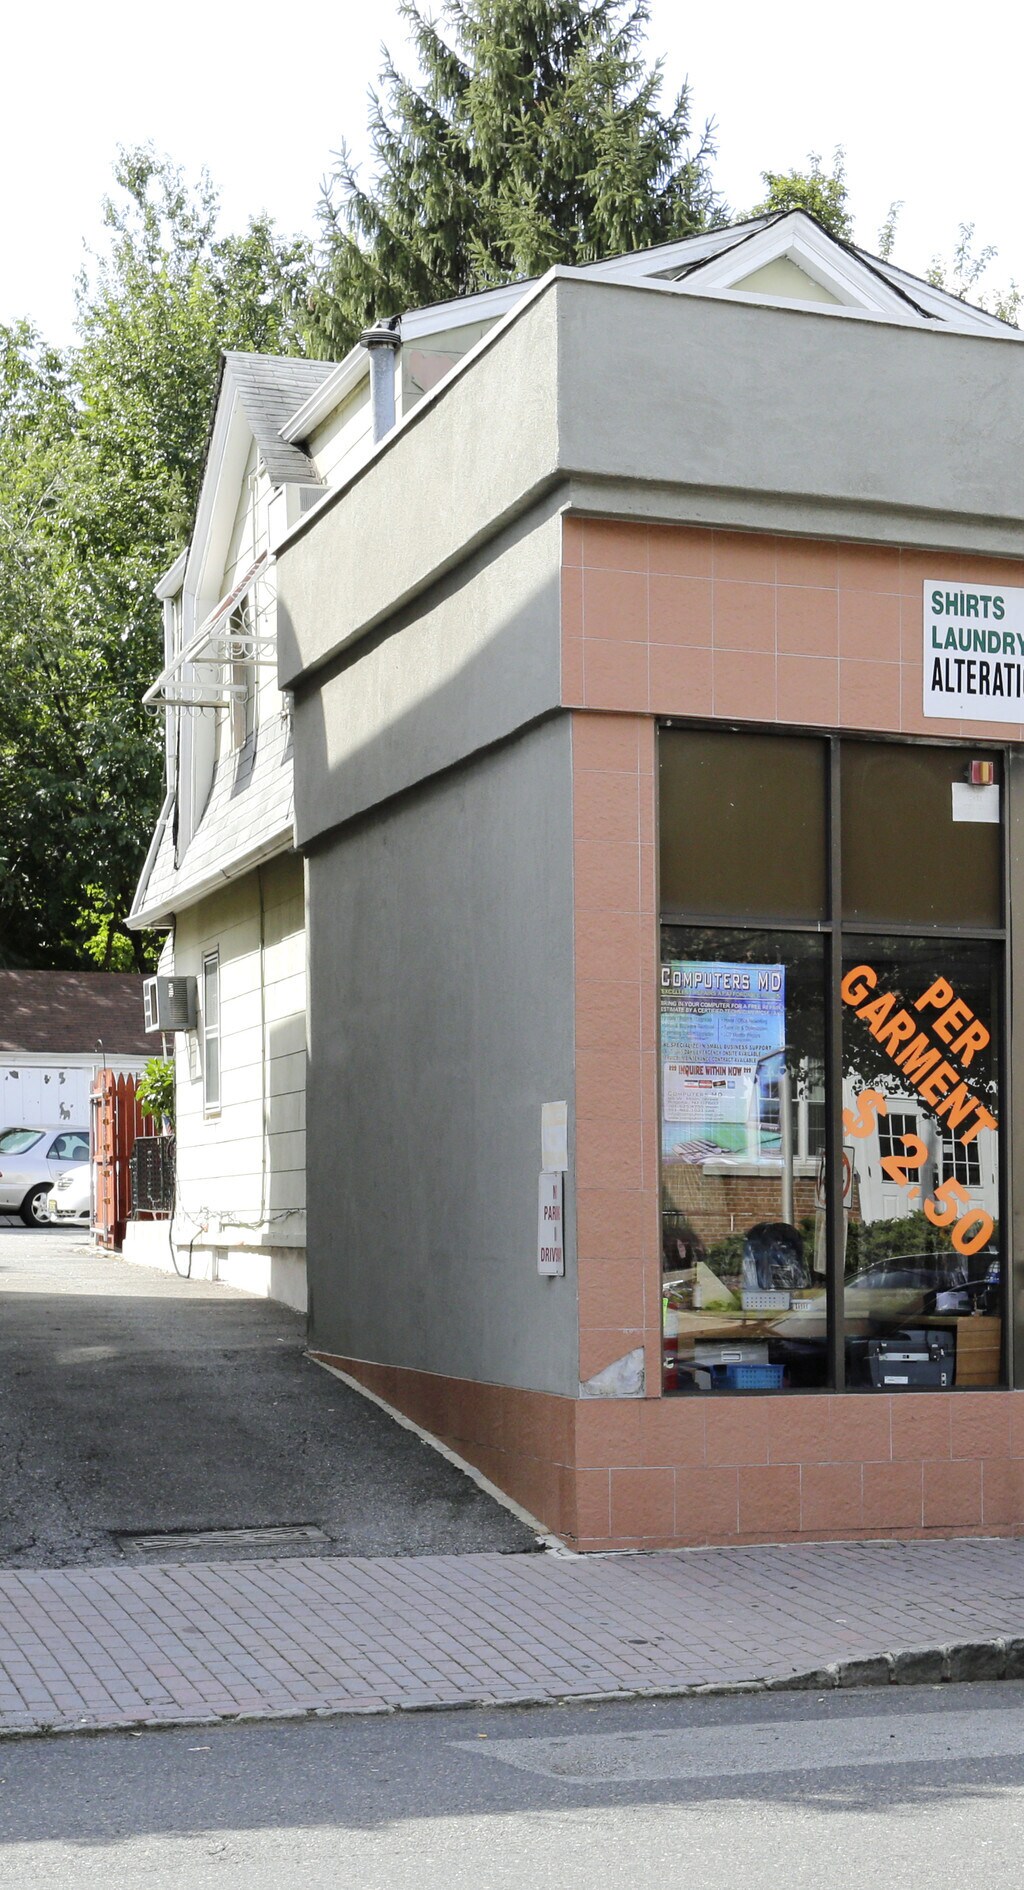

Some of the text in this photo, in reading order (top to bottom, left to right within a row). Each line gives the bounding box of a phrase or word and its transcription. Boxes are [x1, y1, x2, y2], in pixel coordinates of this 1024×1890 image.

[931, 590, 1005, 620] SHIRTS
[661, 967, 781, 991] COMPUTERS MD
[914, 977, 990, 1067] PER
[841, 965, 998, 1146] GARMENT
[706, 1066, 727, 1076] WITHIN
